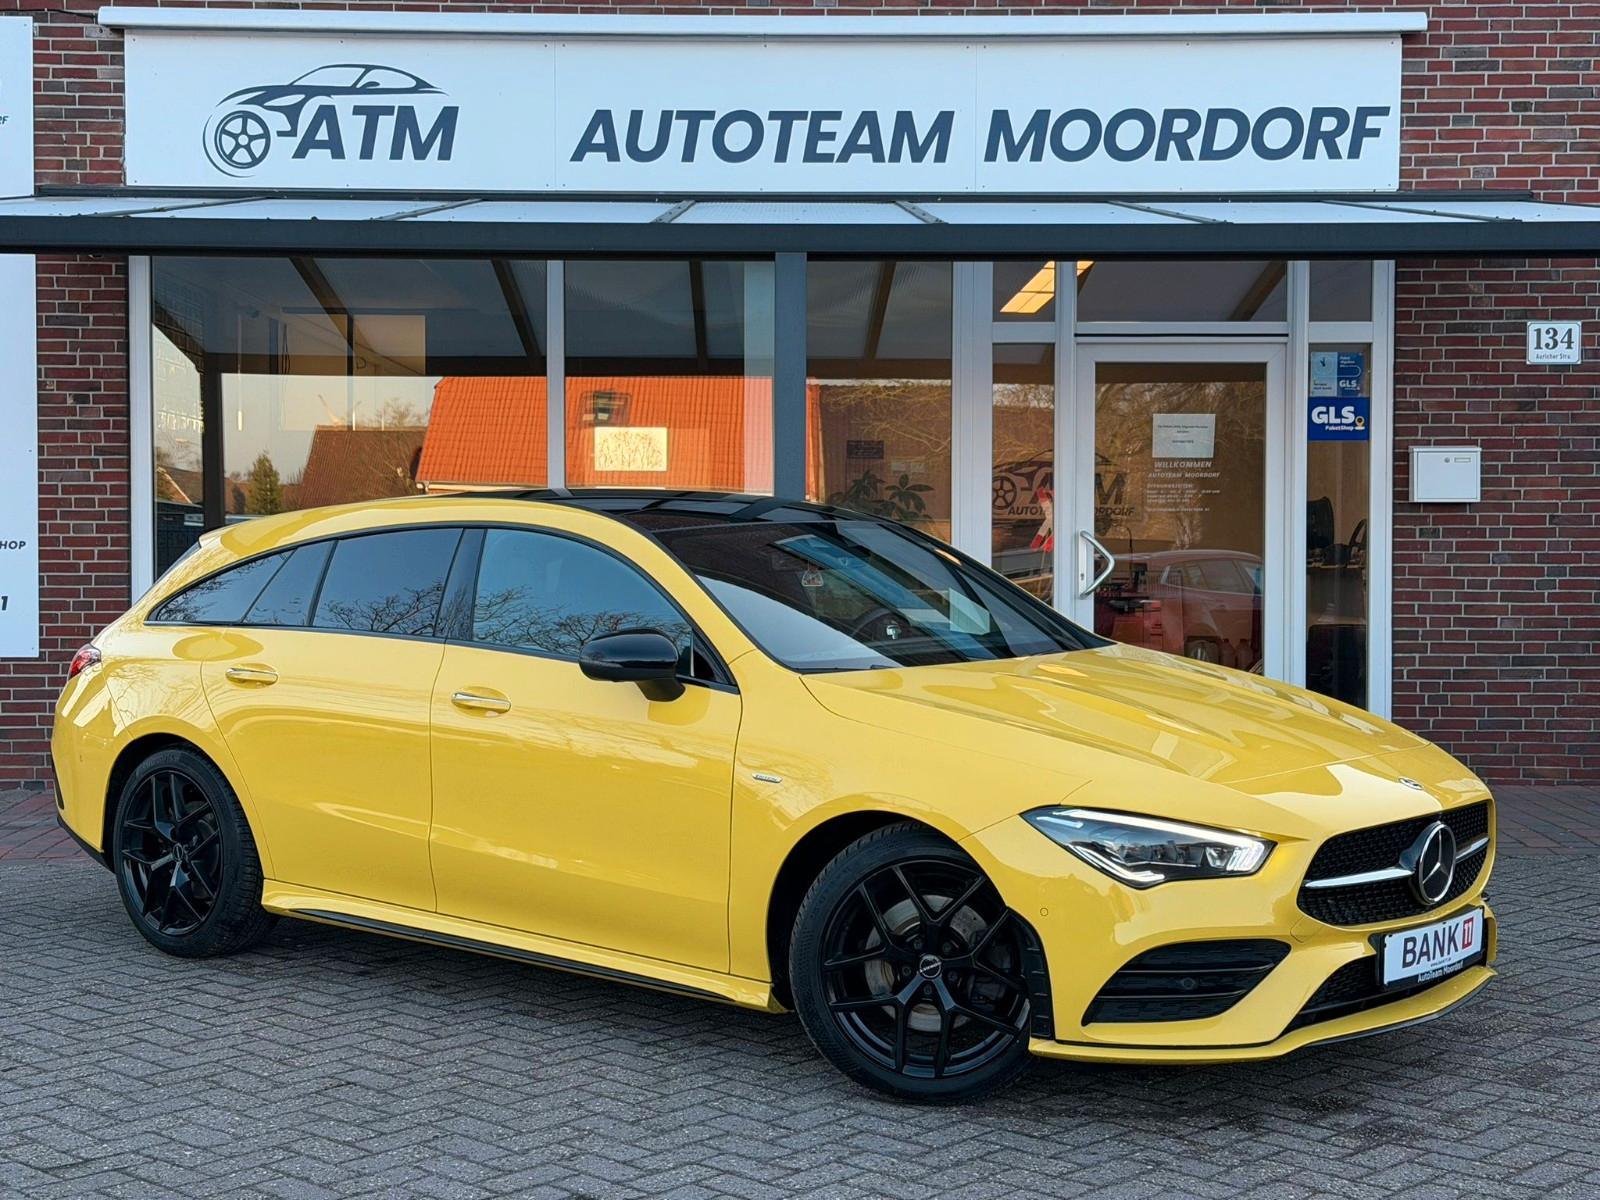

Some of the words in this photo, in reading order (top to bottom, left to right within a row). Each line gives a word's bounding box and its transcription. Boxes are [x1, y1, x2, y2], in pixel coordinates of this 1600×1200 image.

[292, 104, 459, 161] ATM
[569, 109, 955, 164] AUTOTEAM
[983, 106, 1391, 162] MOORDORF
[1533, 327, 1575, 350] 134
[1311, 405, 1355, 424] GLS
[1402, 923, 1459, 968] BANK
